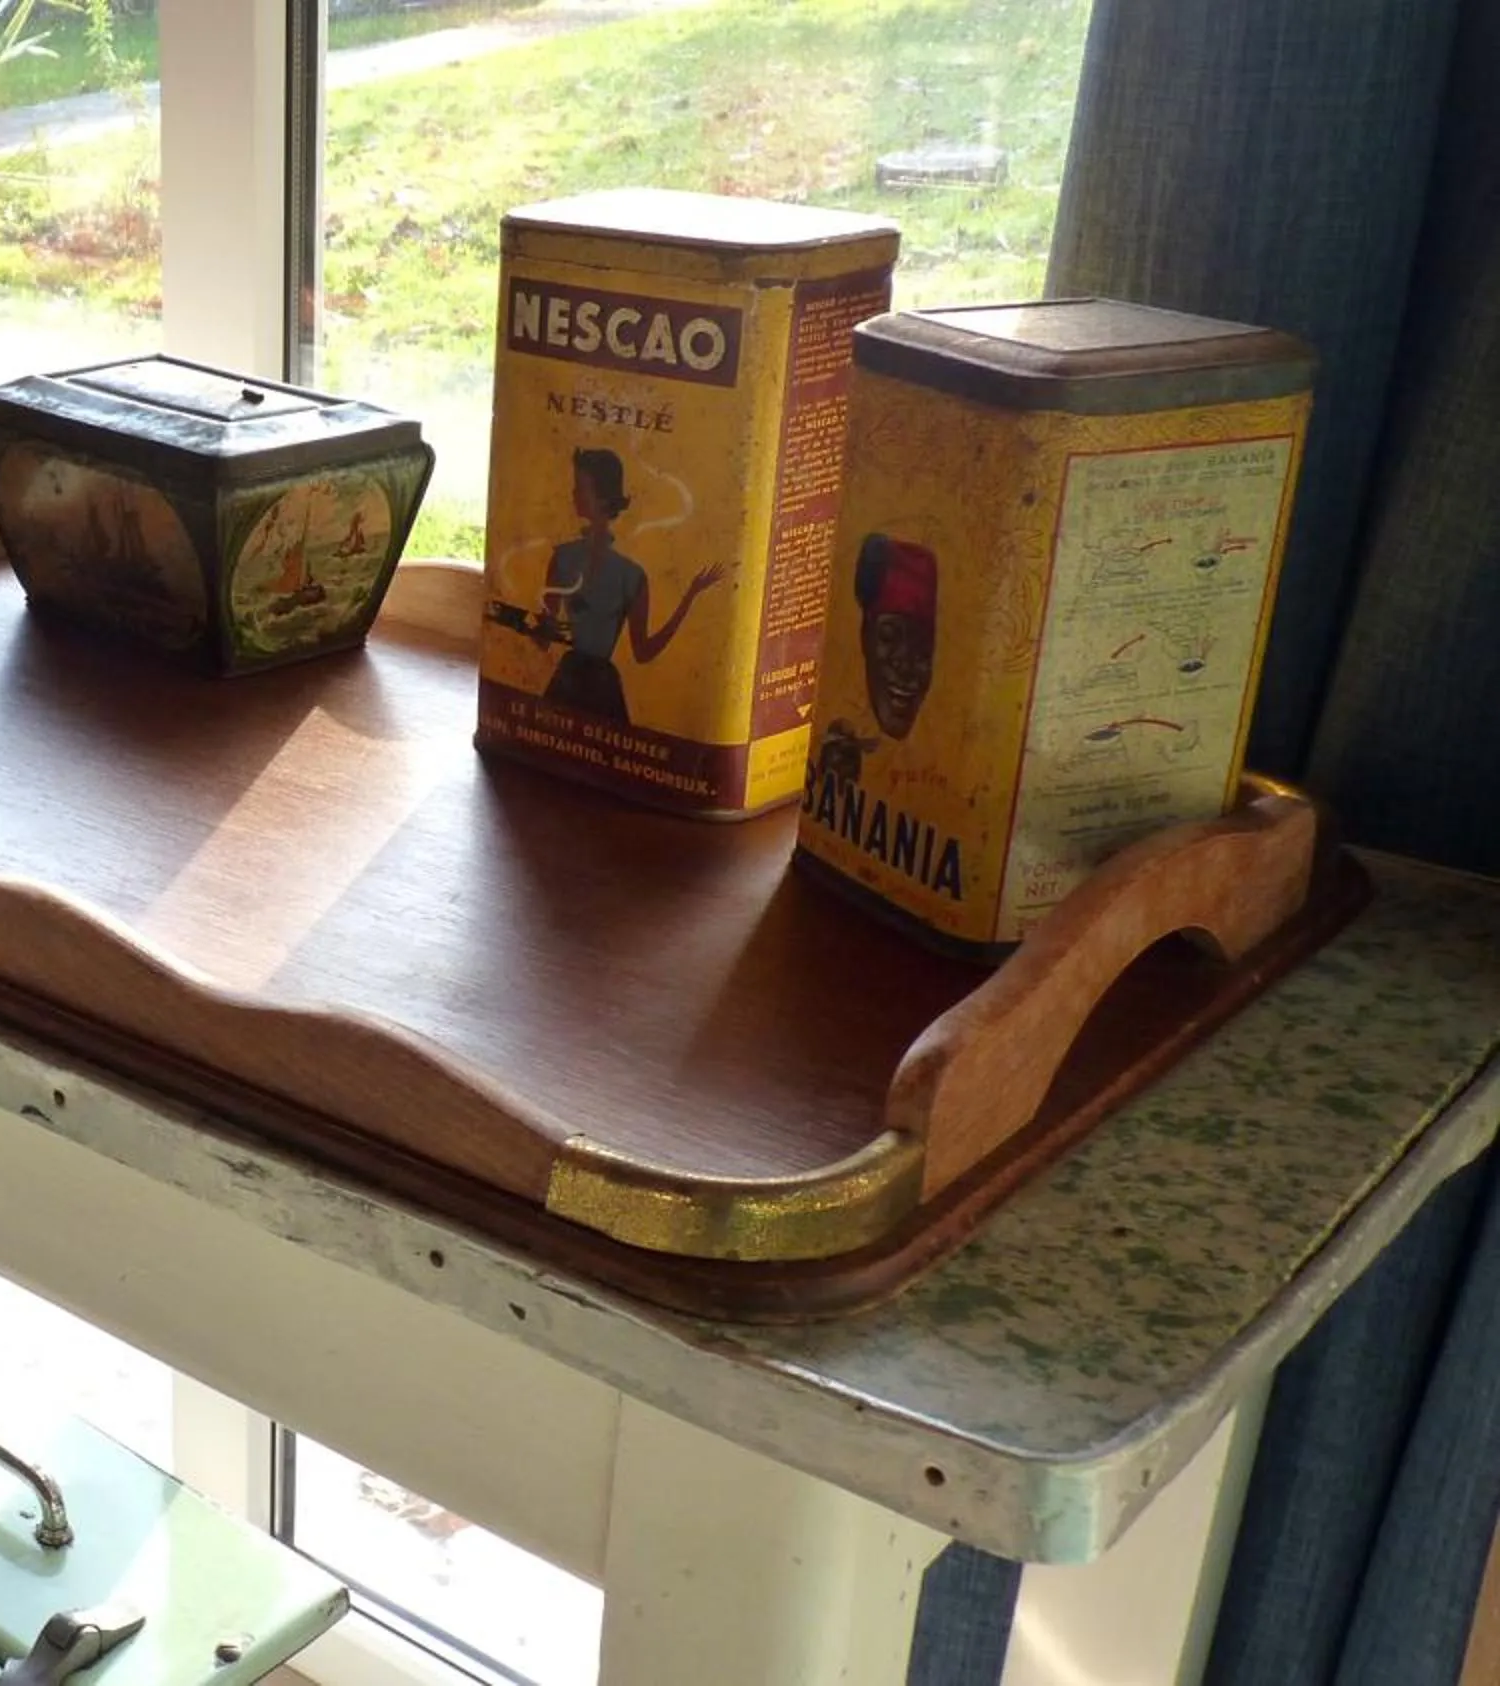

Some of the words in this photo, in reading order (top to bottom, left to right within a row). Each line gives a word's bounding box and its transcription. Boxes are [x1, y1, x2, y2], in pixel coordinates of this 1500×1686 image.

[513, 290, 727, 371] NESCAO
[546, 391, 675, 434] NESTLÉ
[510, 702, 525, 717] LE
